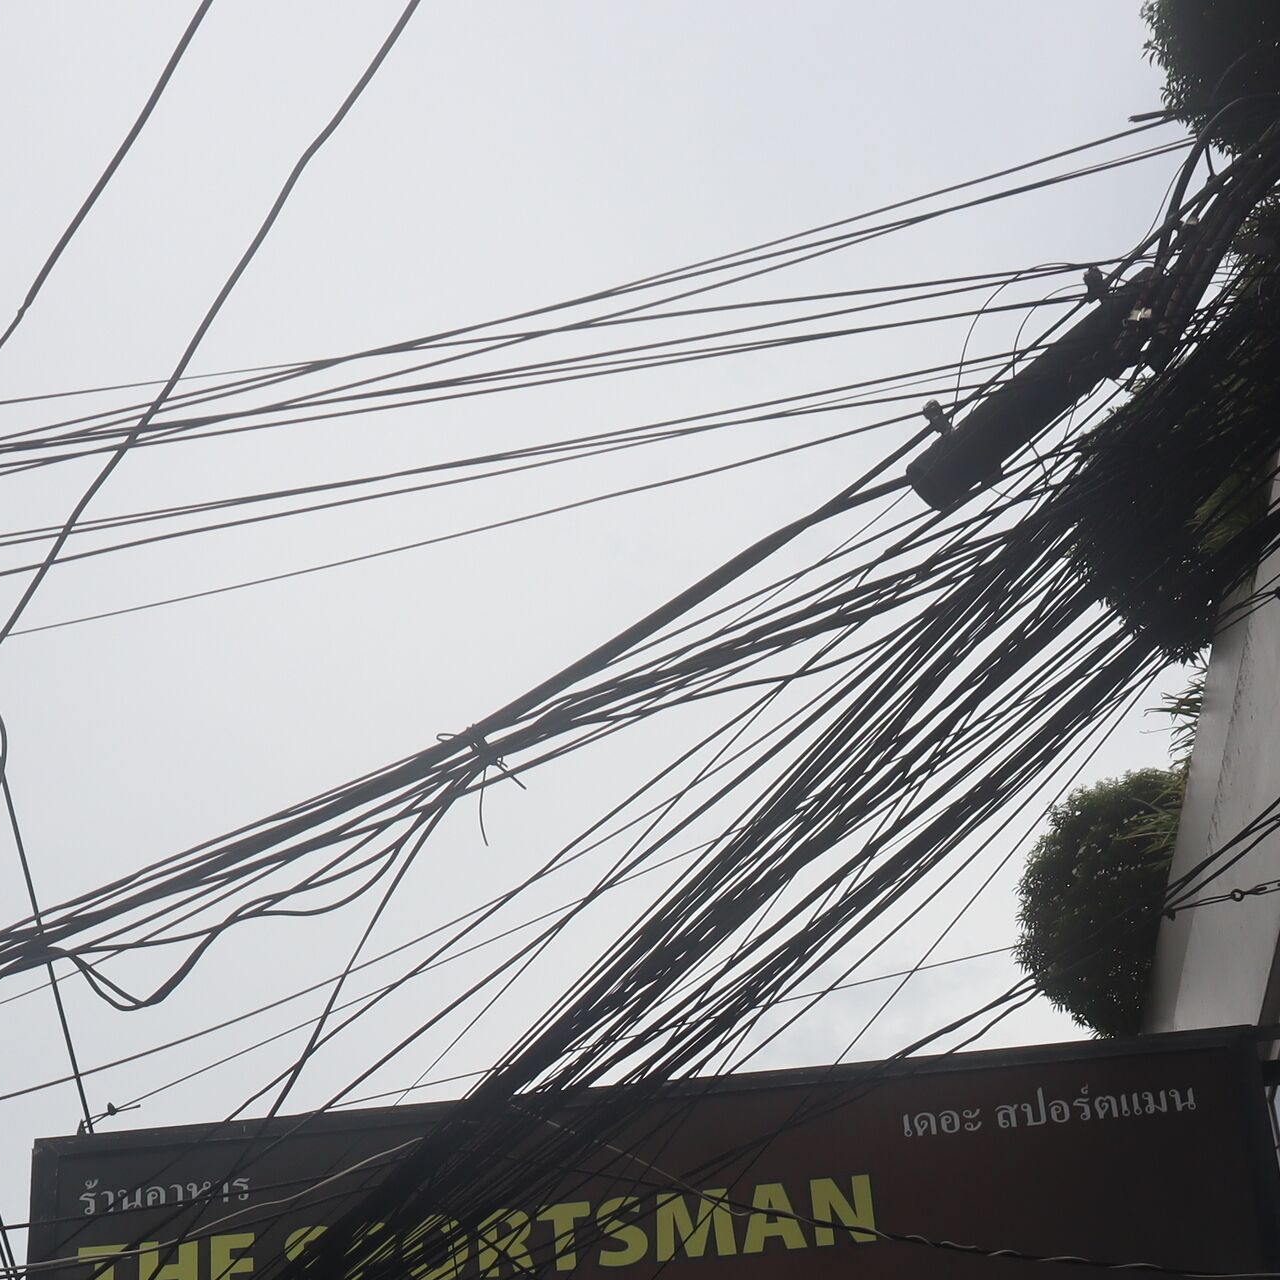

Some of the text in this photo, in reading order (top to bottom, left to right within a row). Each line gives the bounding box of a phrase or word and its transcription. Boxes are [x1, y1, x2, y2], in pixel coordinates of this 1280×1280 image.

[901, 1085, 1197, 1138] เดอะ สปอร์ตแมน
